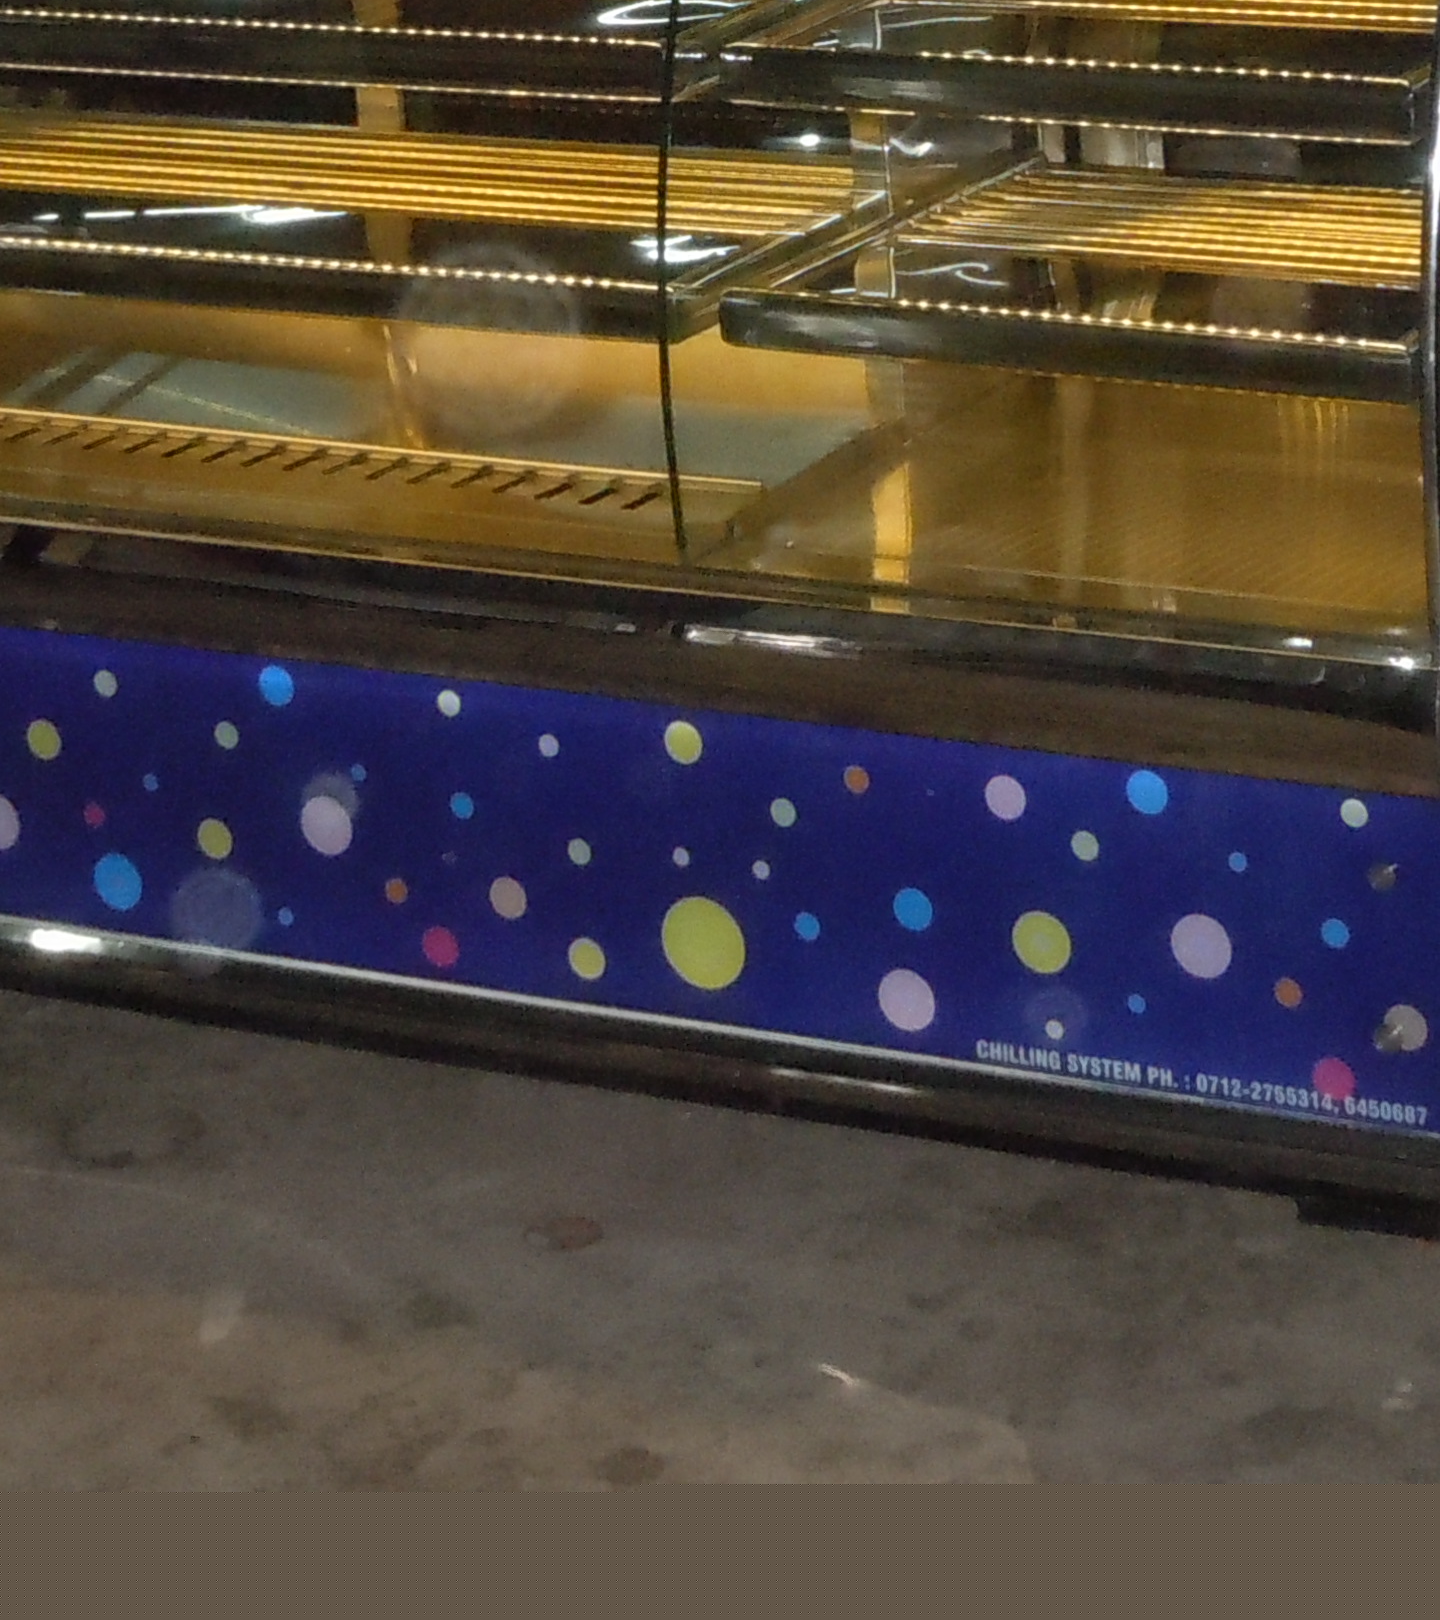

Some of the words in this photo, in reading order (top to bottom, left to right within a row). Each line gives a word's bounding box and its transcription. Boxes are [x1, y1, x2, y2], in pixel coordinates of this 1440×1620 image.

[976, 1039, 1061, 1070] CHILLING
[1067, 1053, 1141, 1083] SYSTEM
[1147, 1065, 1179, 1089] PH.
[1344, 1095, 1427, 1125] 6450687
